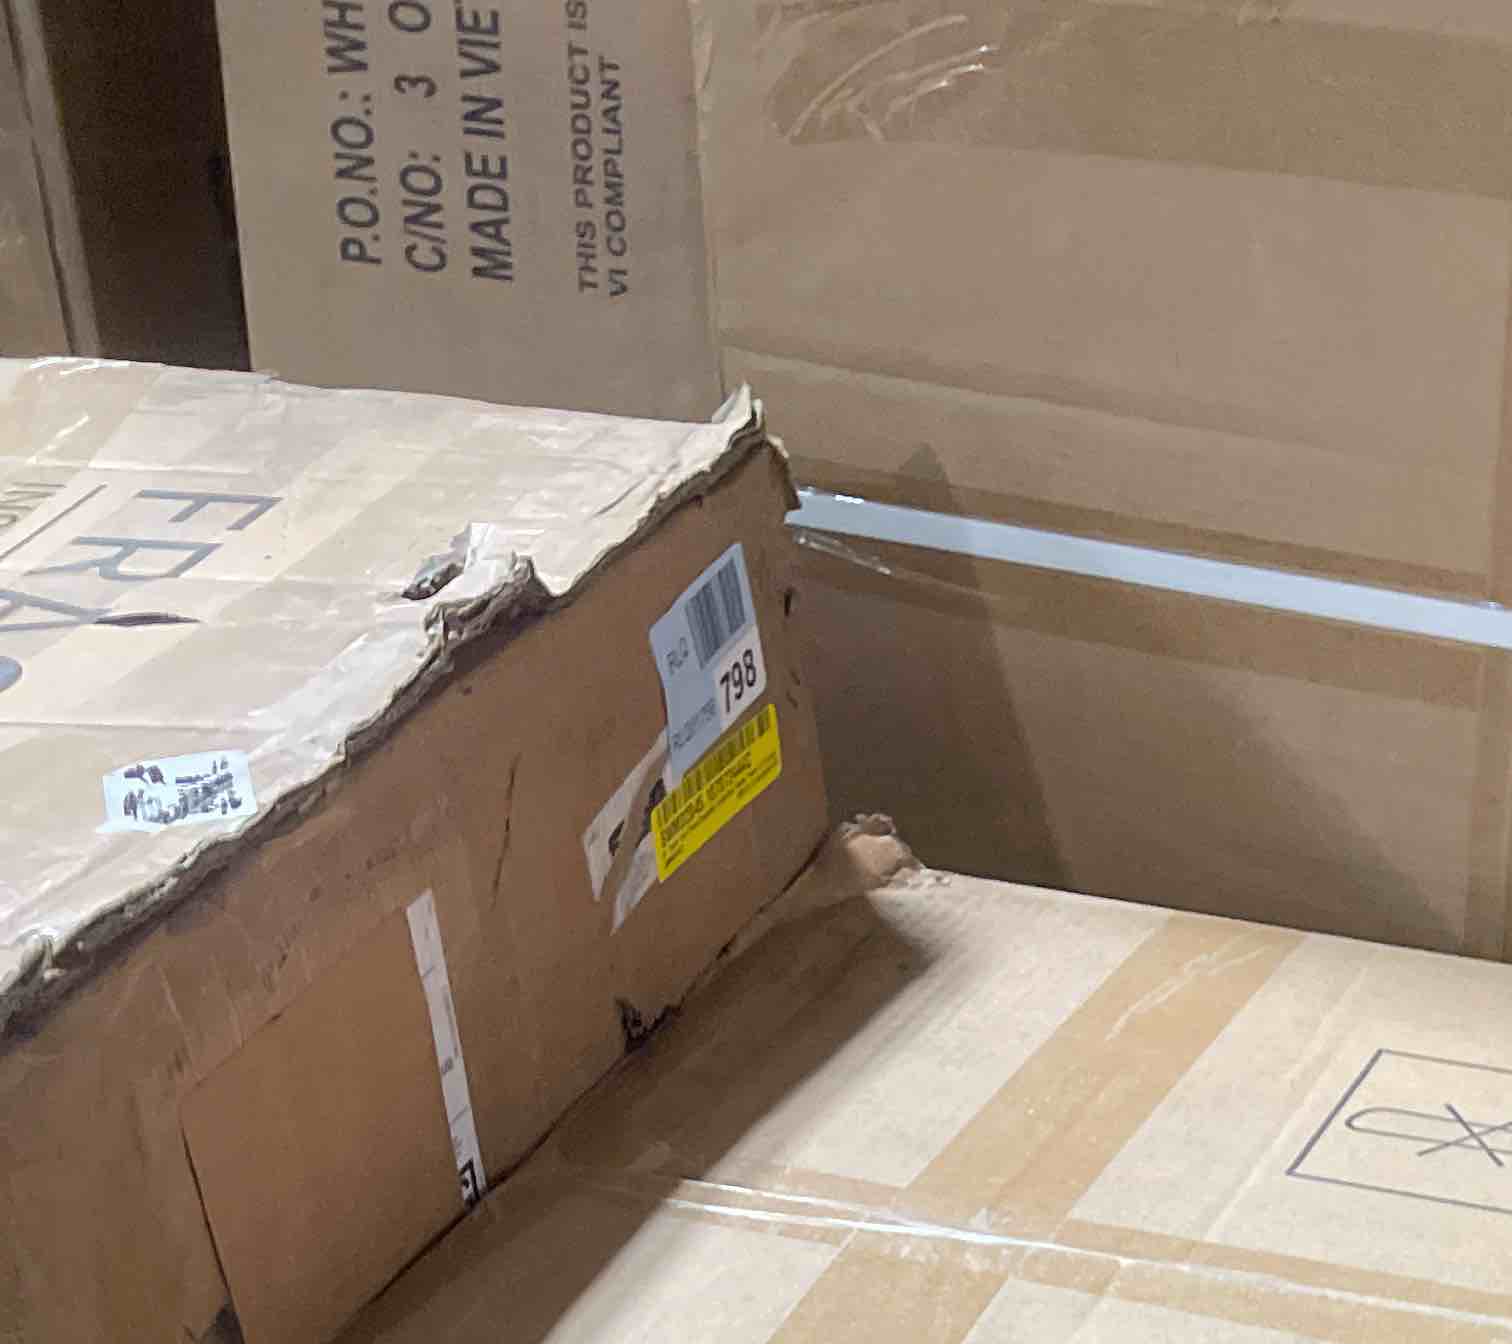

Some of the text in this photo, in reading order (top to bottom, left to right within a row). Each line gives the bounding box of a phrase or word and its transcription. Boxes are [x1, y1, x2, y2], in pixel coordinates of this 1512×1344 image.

[393, 74, 438, 98] 3
[455, 0, 514, 283] MADE IN VIE
[564, 0, 599, 293] THIS PRODUCT IS
[330, 91, 382, 266] P.O.NO.:
[399, 151, 448, 273] C/NO:
[598, 55, 629, 297] VI COMPLIANT
[718, 648, 758, 715] 798
